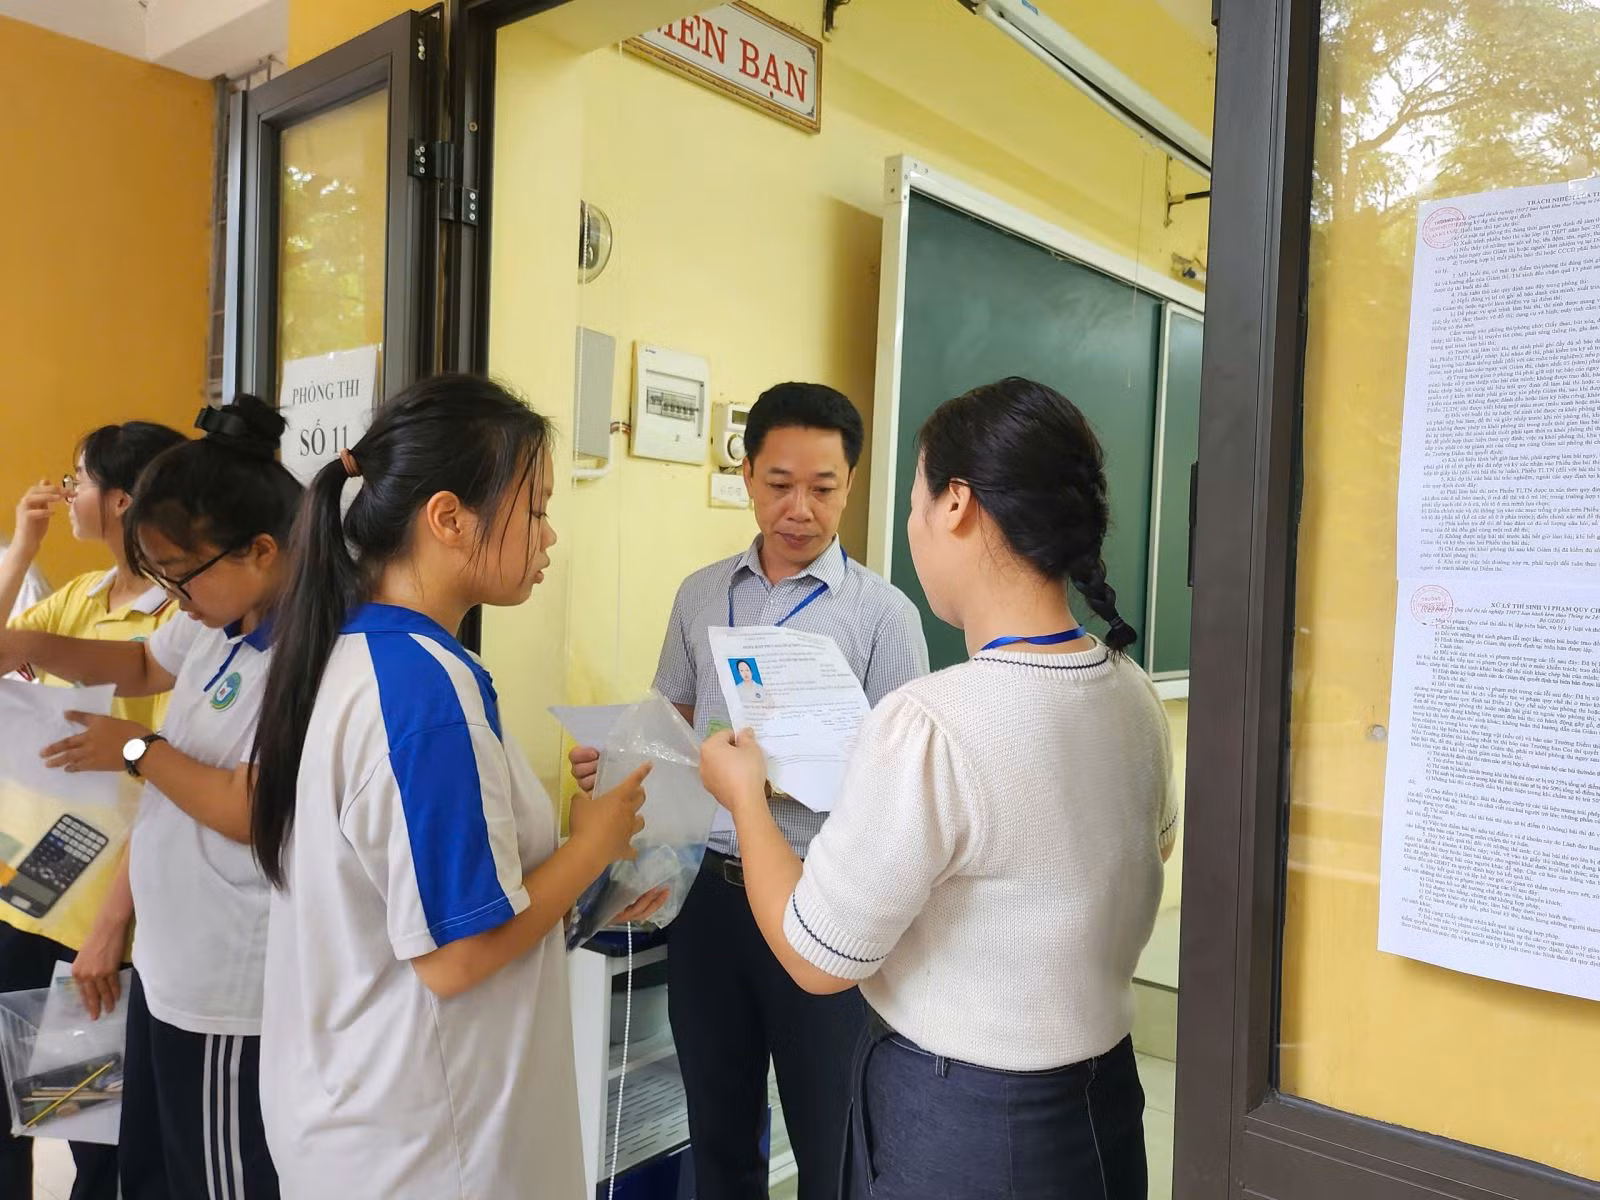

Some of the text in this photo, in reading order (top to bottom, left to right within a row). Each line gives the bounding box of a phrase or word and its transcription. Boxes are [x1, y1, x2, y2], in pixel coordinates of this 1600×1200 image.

[738, 37, 807, 102] BẠN
[292, 379, 360, 405] PHÒNG THI
[300, 419, 348, 457] SỐ 11
